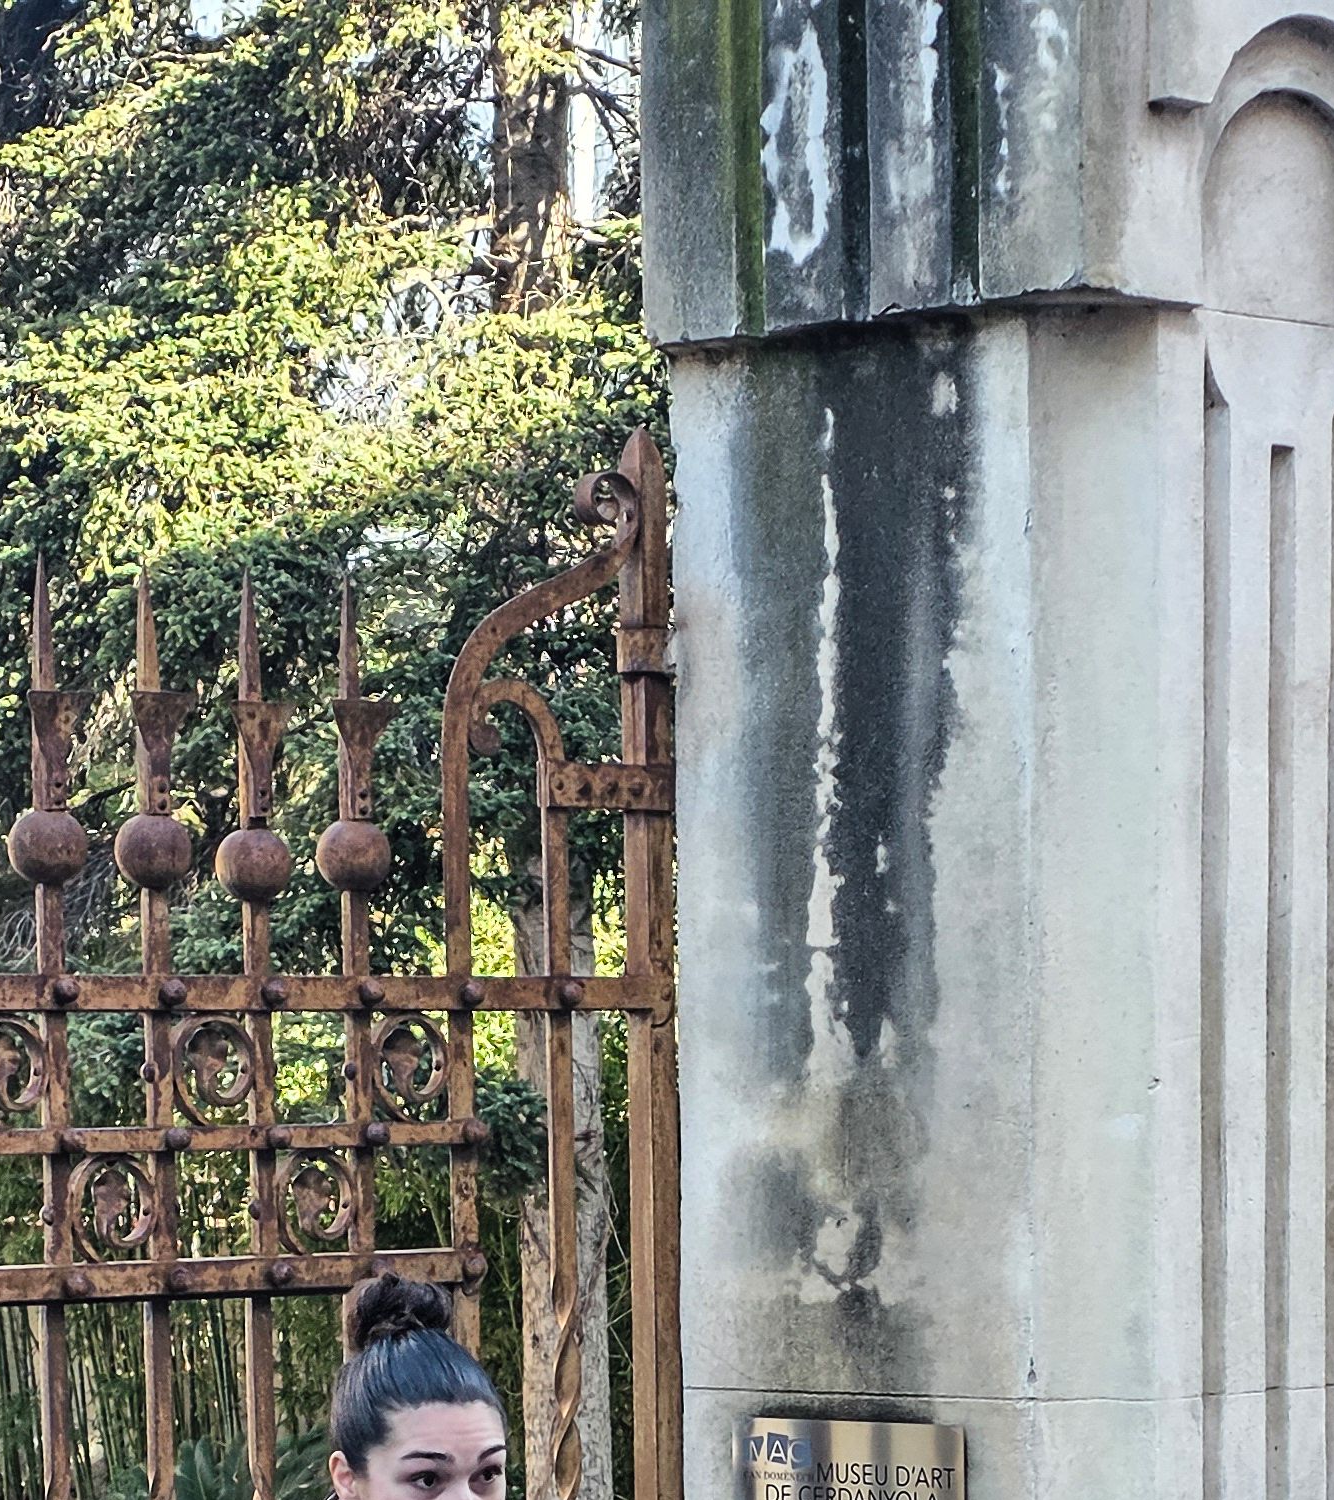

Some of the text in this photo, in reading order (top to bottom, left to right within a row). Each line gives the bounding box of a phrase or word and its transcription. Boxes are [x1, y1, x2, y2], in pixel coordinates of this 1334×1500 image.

[748, 1438, 807, 1464] MAC
[817, 1462, 955, 1490] MUSEU D'ART
